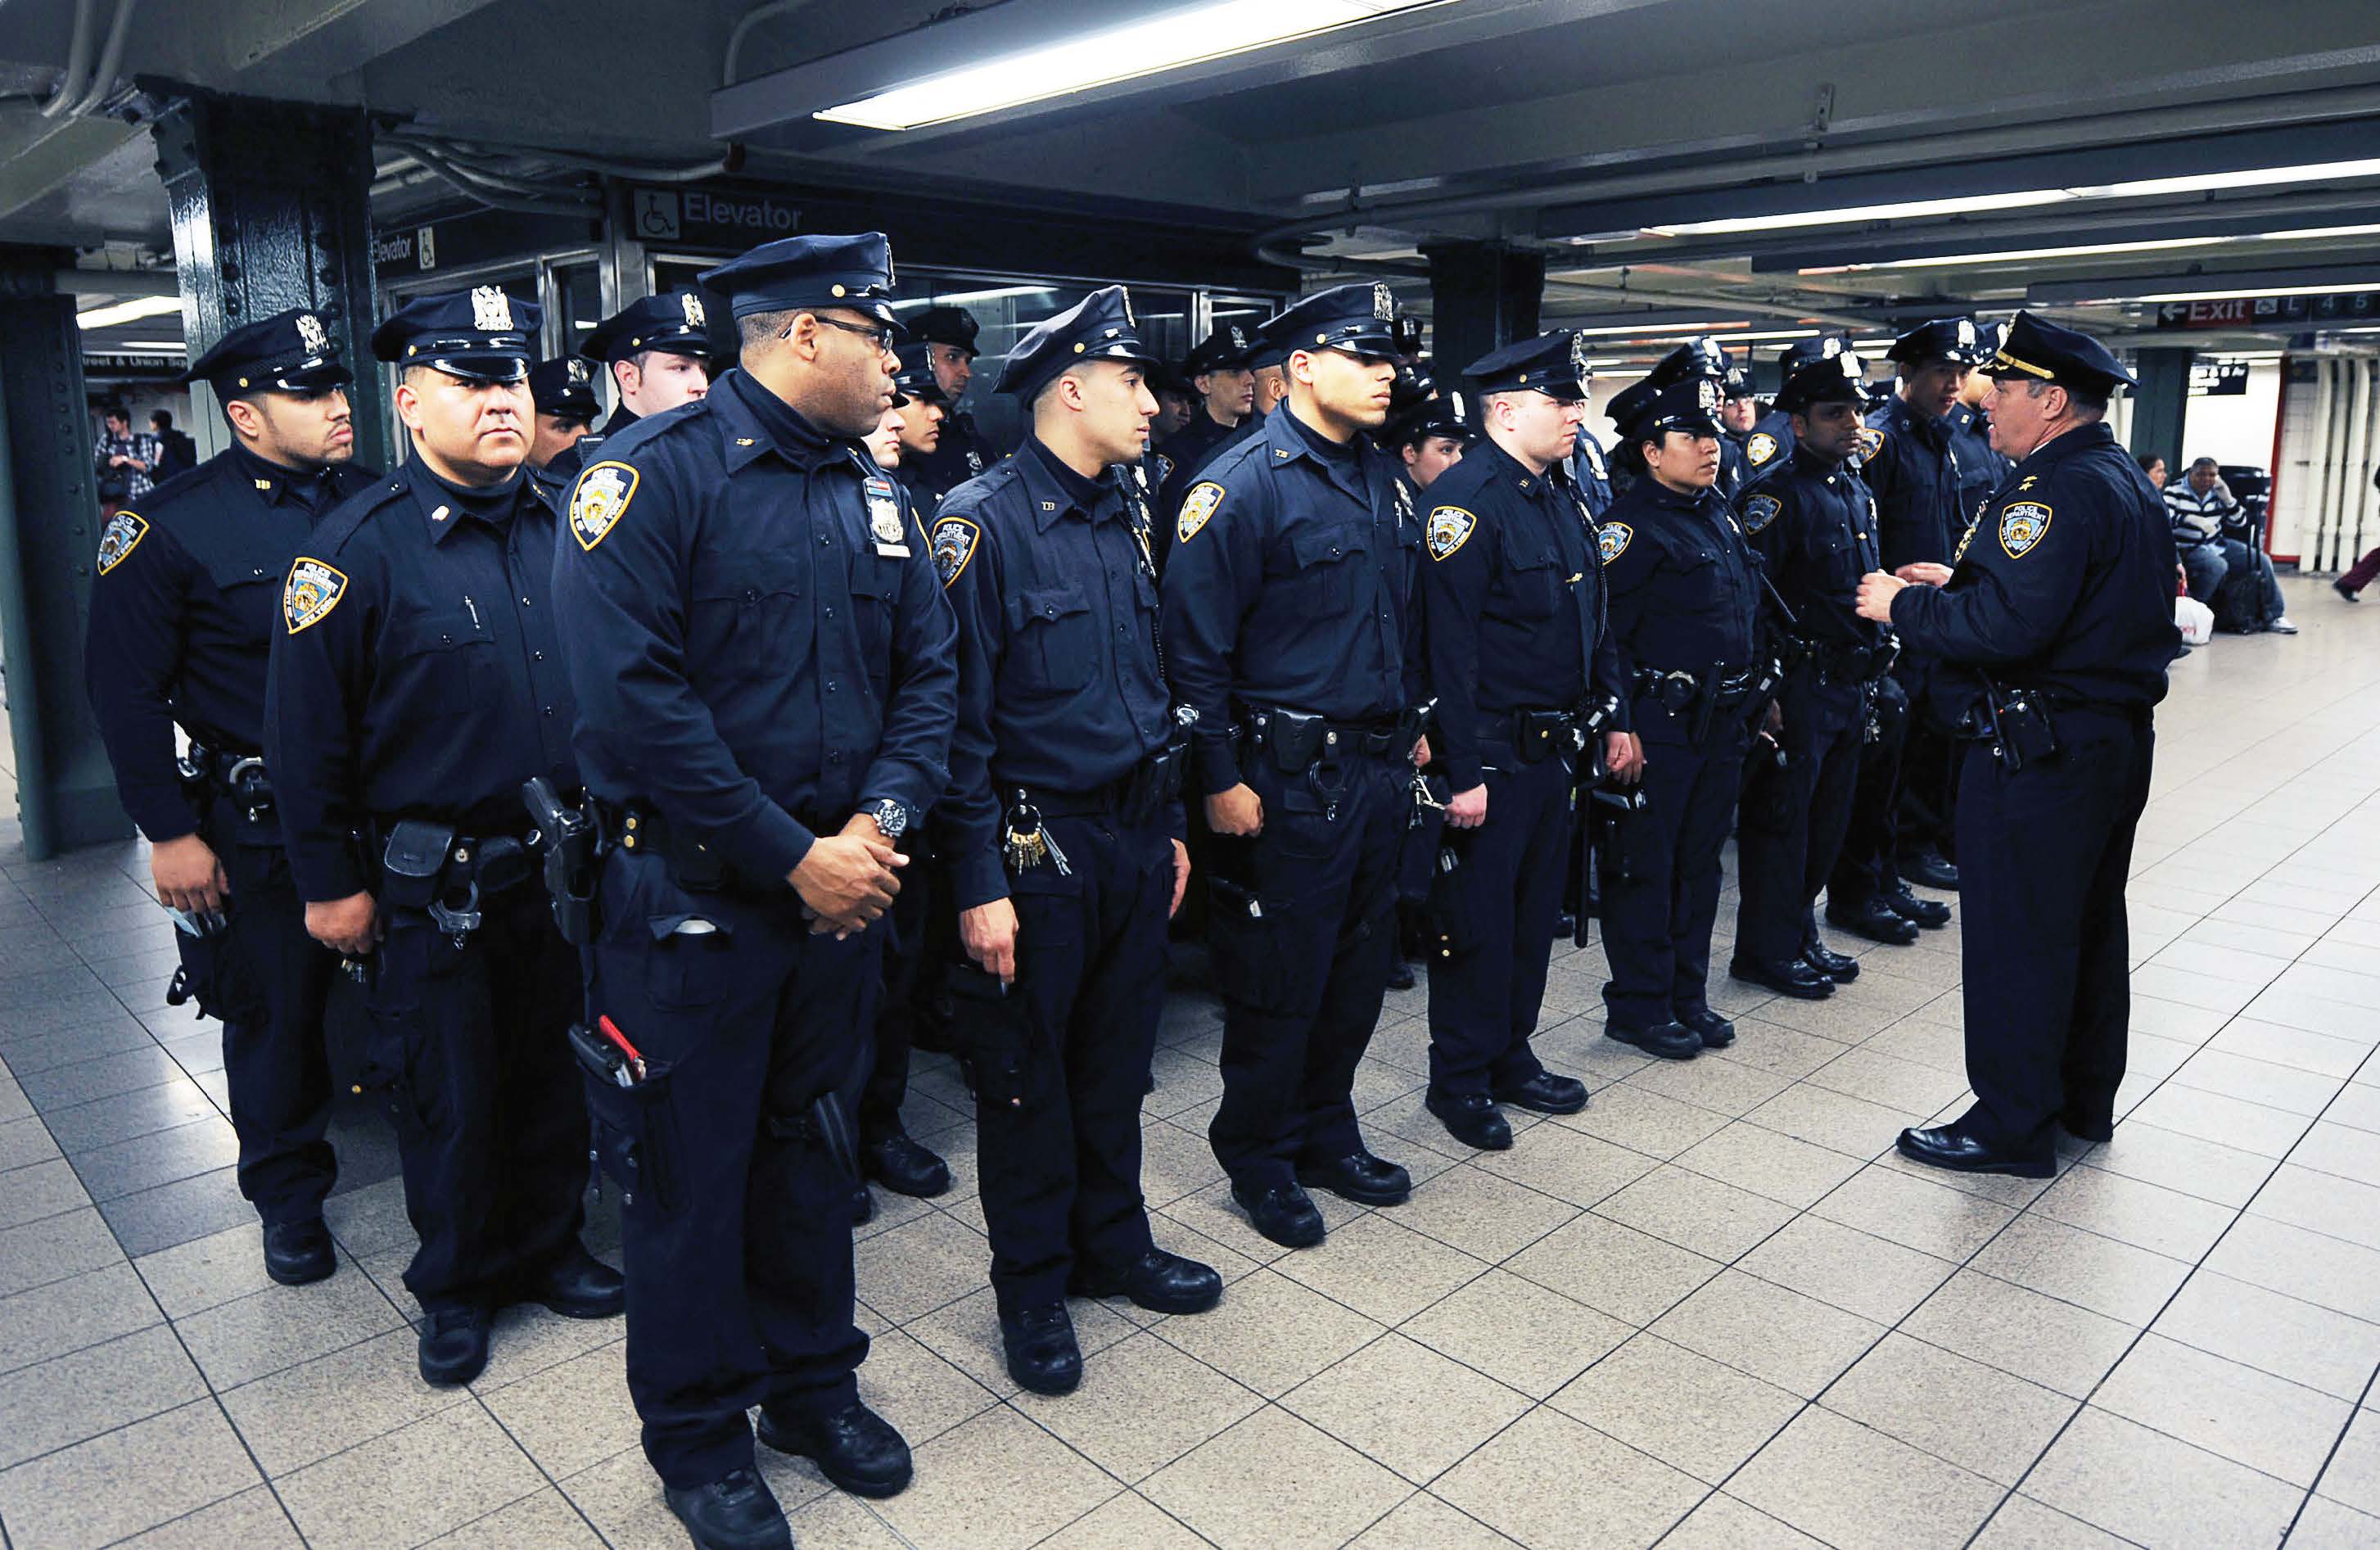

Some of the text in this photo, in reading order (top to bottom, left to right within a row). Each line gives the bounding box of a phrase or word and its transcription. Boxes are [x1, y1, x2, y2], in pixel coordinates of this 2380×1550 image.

[683, 192, 802, 230] Elevator
[2189, 298, 2246, 321] Exit
[2014, 505, 2038, 513] POLICE
[294, 570, 338, 593] DEPARTMENT
[305, 563, 331, 579] POLICE
